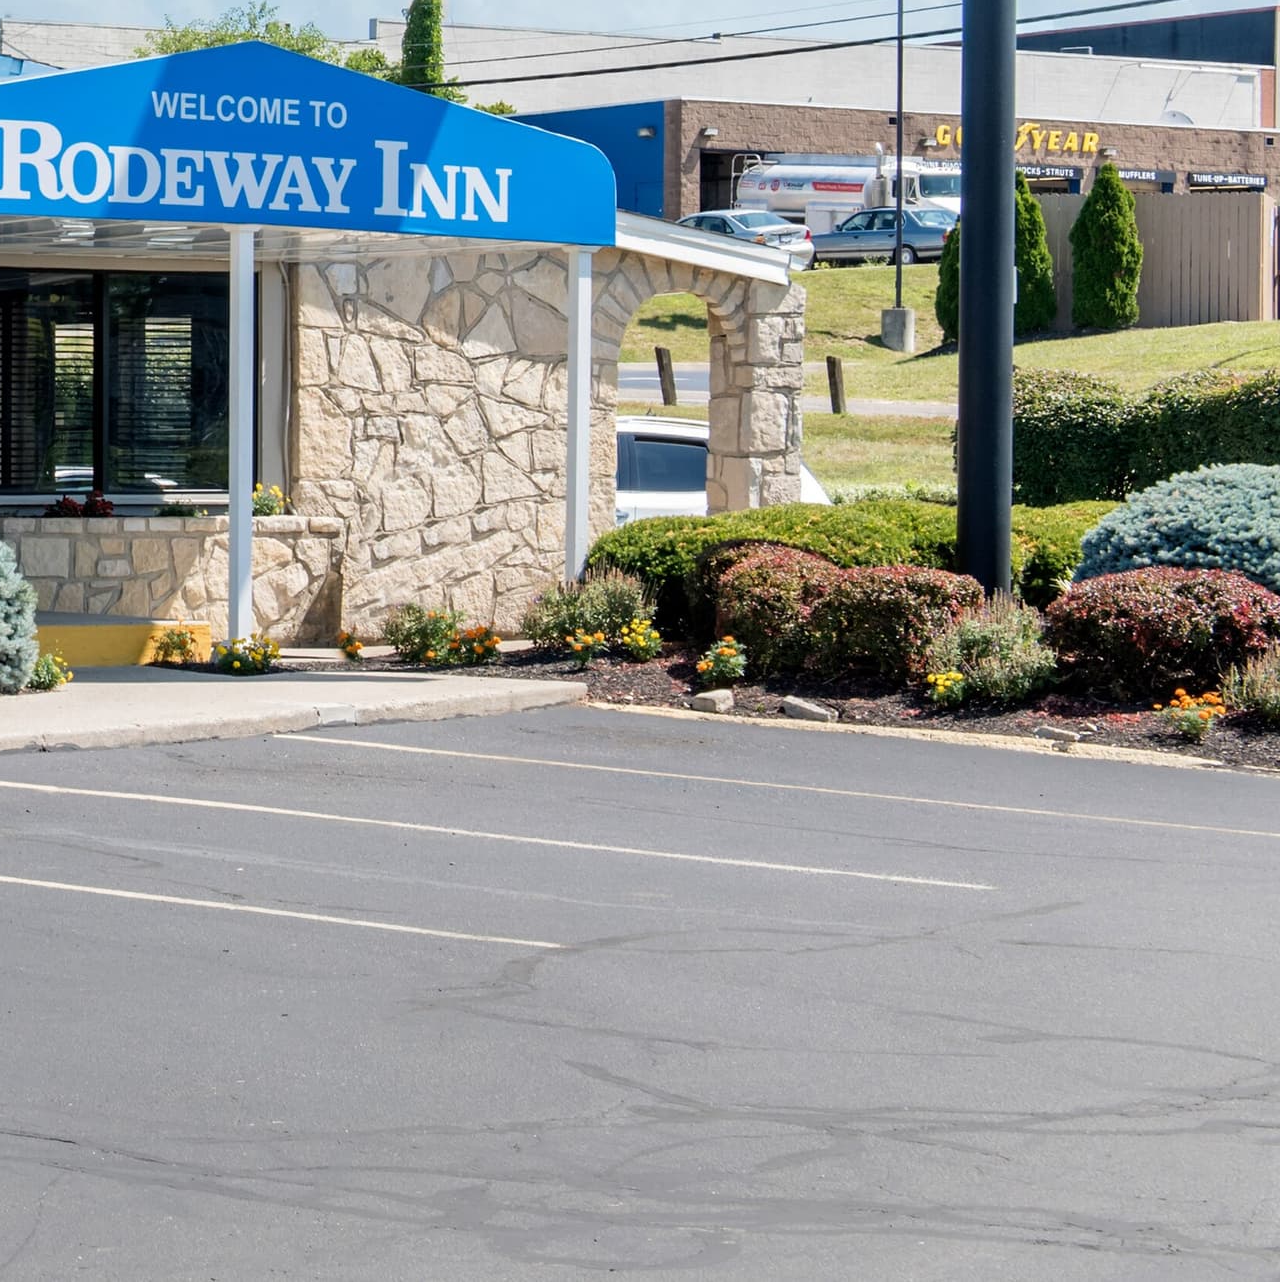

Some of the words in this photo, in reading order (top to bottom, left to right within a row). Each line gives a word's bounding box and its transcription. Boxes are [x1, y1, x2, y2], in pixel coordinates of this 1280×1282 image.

[151, 91, 301, 126] WELCOME
[309, 100, 348, 129] TO
[936, 122, 1100, 153] GYEAR
[374, 139, 513, 223] INN
[1118, 170, 1156, 180] MUFFLERS
